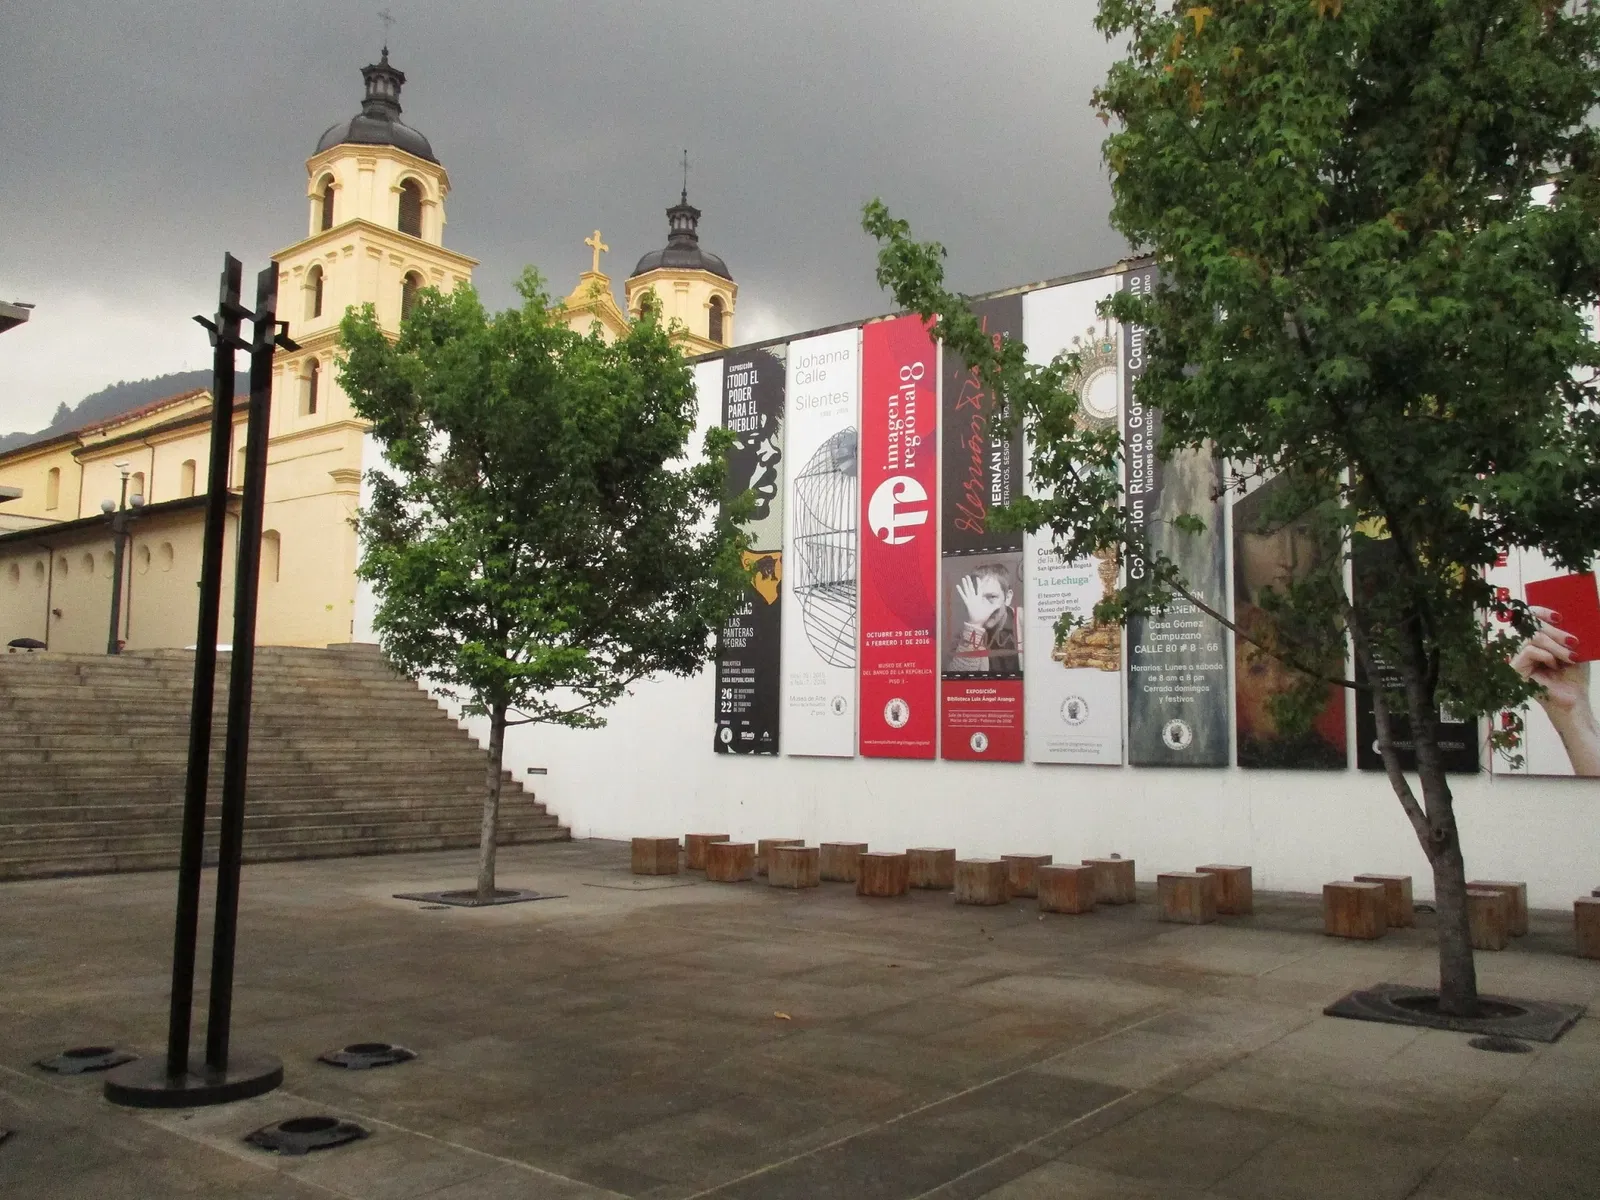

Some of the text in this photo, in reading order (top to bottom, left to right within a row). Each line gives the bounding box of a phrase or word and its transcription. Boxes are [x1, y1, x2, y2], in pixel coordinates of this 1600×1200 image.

[796, 349, 849, 370] Johanna
[727, 370, 759, 389] ¡TODO EL
[796, 368, 826, 385] Calle
[728, 386, 752, 403] PODER
[796, 391, 849, 410] Silentes
[728, 400, 758, 419] PARA EL
[899, 361, 925, 469] regional 8
[728, 415, 758, 432] PUEBLO!
[882, 393, 904, 470] imagen
[1144, 435, 1154, 447] de
[1129, 432, 1144, 495] Ricardo
[1144, 451, 1154, 493] Visiones
[728, 617, 741, 628] LAS
[1148, 618, 1204, 629] Casa Gómez
[723, 627, 754, 638] PANTERAS
[1150, 632, 1202, 642] Campuzano
[1134, 644, 1163, 653] CALLE
[1165, 644, 1177, 653] 80
[1180, 644, 1187, 652] #
[1190, 643, 1196, 652] 8
[1206, 643, 1219, 652] 66
[1164, 663, 1187, 671] Lunes
[1193, 674, 1205, 682] pm
[721, 687, 733, 700] 26
[1174, 685, 1210, 693] domingos
[982, 695, 997, 703] Ángel
[1165, 695, 1194, 703] festivos
[721, 701, 732, 713] 22
